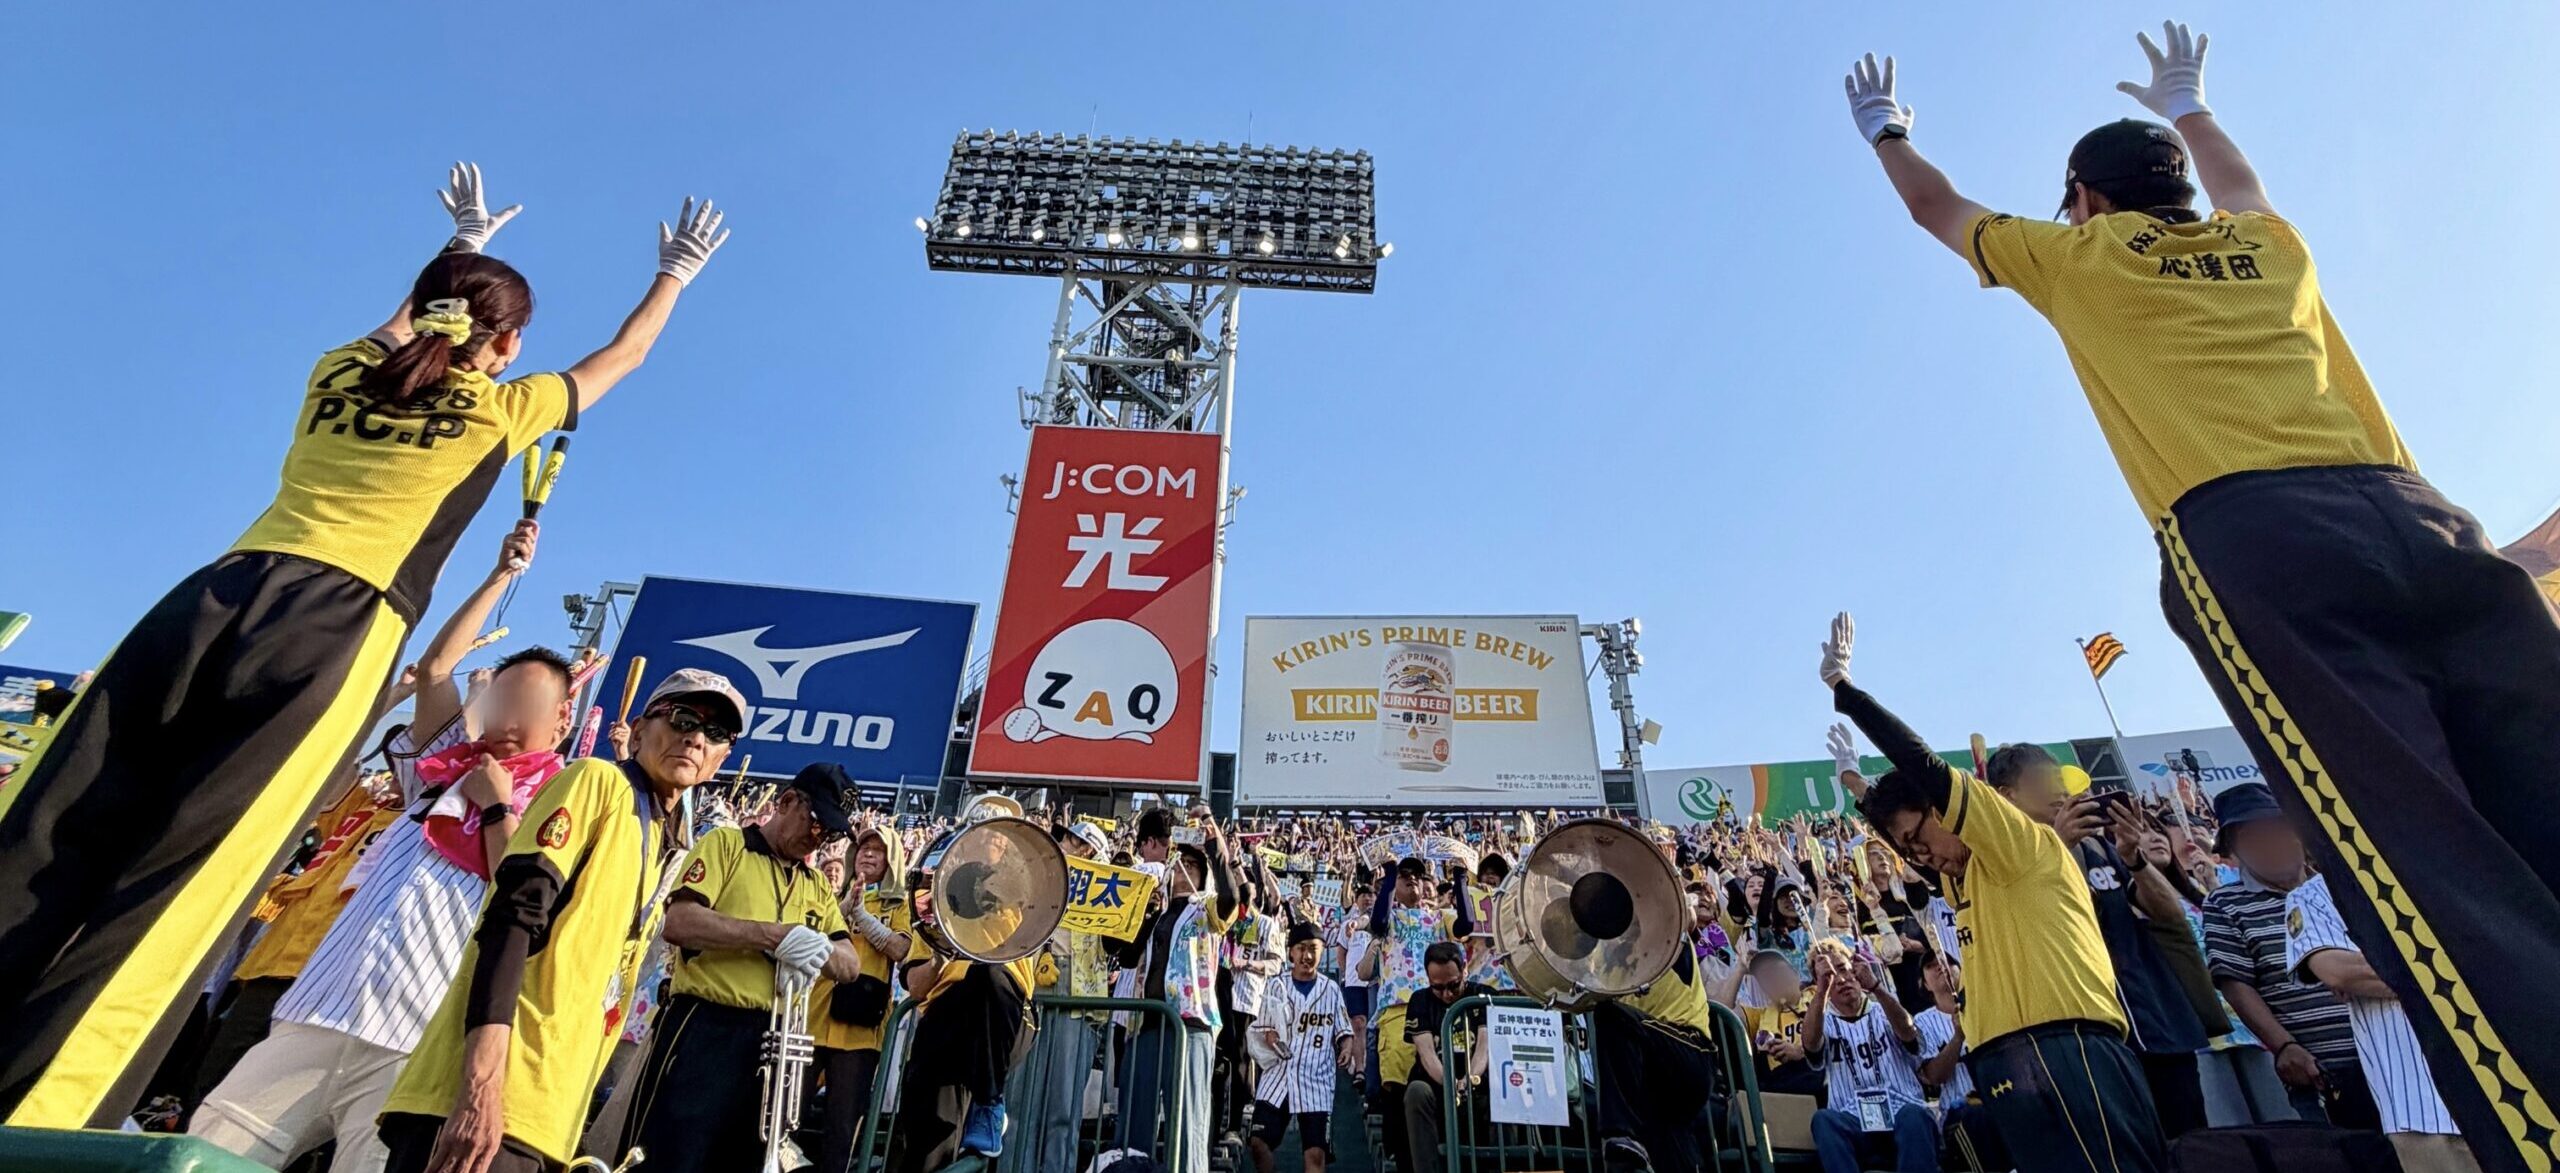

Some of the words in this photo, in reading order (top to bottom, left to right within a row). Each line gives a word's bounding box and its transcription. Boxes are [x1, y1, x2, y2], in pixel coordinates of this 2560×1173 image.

[2158, 253, 2263, 281] 応援団
[1043, 461, 1196, 499] J:COM
[1062, 512, 1170, 592] 光
[1271, 628, 1373, 674] KIRIN'S
[1382, 626, 1466, 648] PRIME
[1475, 632, 1555, 671] BREW
[1037, 671, 1161, 725] ZAQ
[1383, 694, 1417, 707] KIRIN
[1420, 697, 1449, 711] BEER
[1455, 695, 1525, 715] BEER
[1391, 711, 1437, 725] 一番搾り
[1265, 730, 1355, 742] おいしいとこだけ
[1265, 752, 1327, 764] 搾ってます。
[1298, 1011, 1334, 1033] gers
[1313, 1034, 1323, 1048] 8
[1829, 1031, 1889, 1069] Tiger
